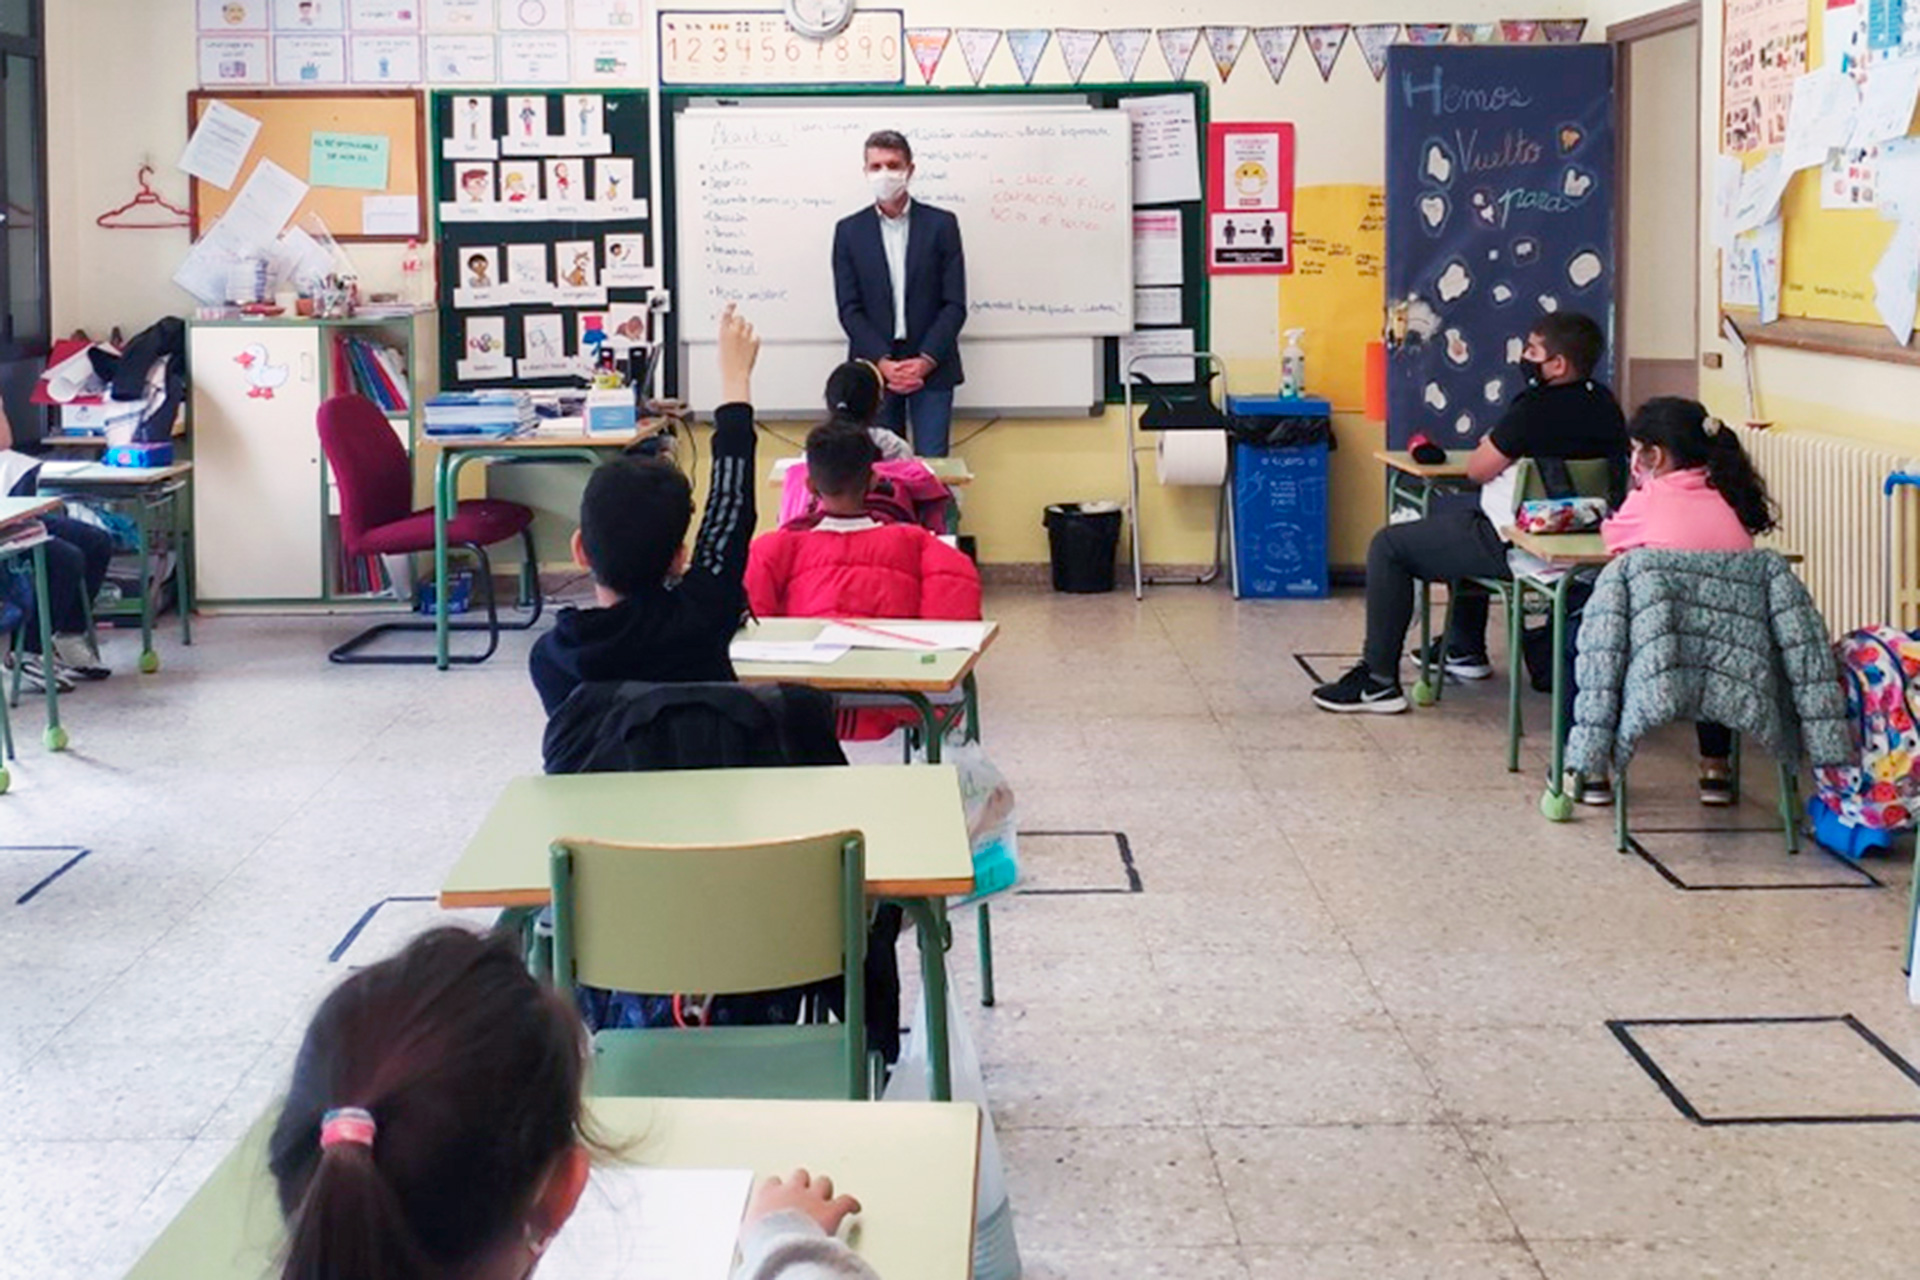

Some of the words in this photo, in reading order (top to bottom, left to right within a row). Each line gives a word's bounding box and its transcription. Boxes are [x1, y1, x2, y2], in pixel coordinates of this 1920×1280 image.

[667, 37, 678, 61] 1
[687, 37, 703, 63] 2
[712, 37, 728, 63] 3
[736, 37, 751, 61] 4
[761, 37, 776, 62] 5
[785, 36, 801, 62] 6
[834, 36, 849, 62] 8
[858, 35, 872, 60] 9
[881, 35, 897, 61] 0
[1402, 65, 1532, 115] Hemos
[1498, 187, 1574, 229] para
